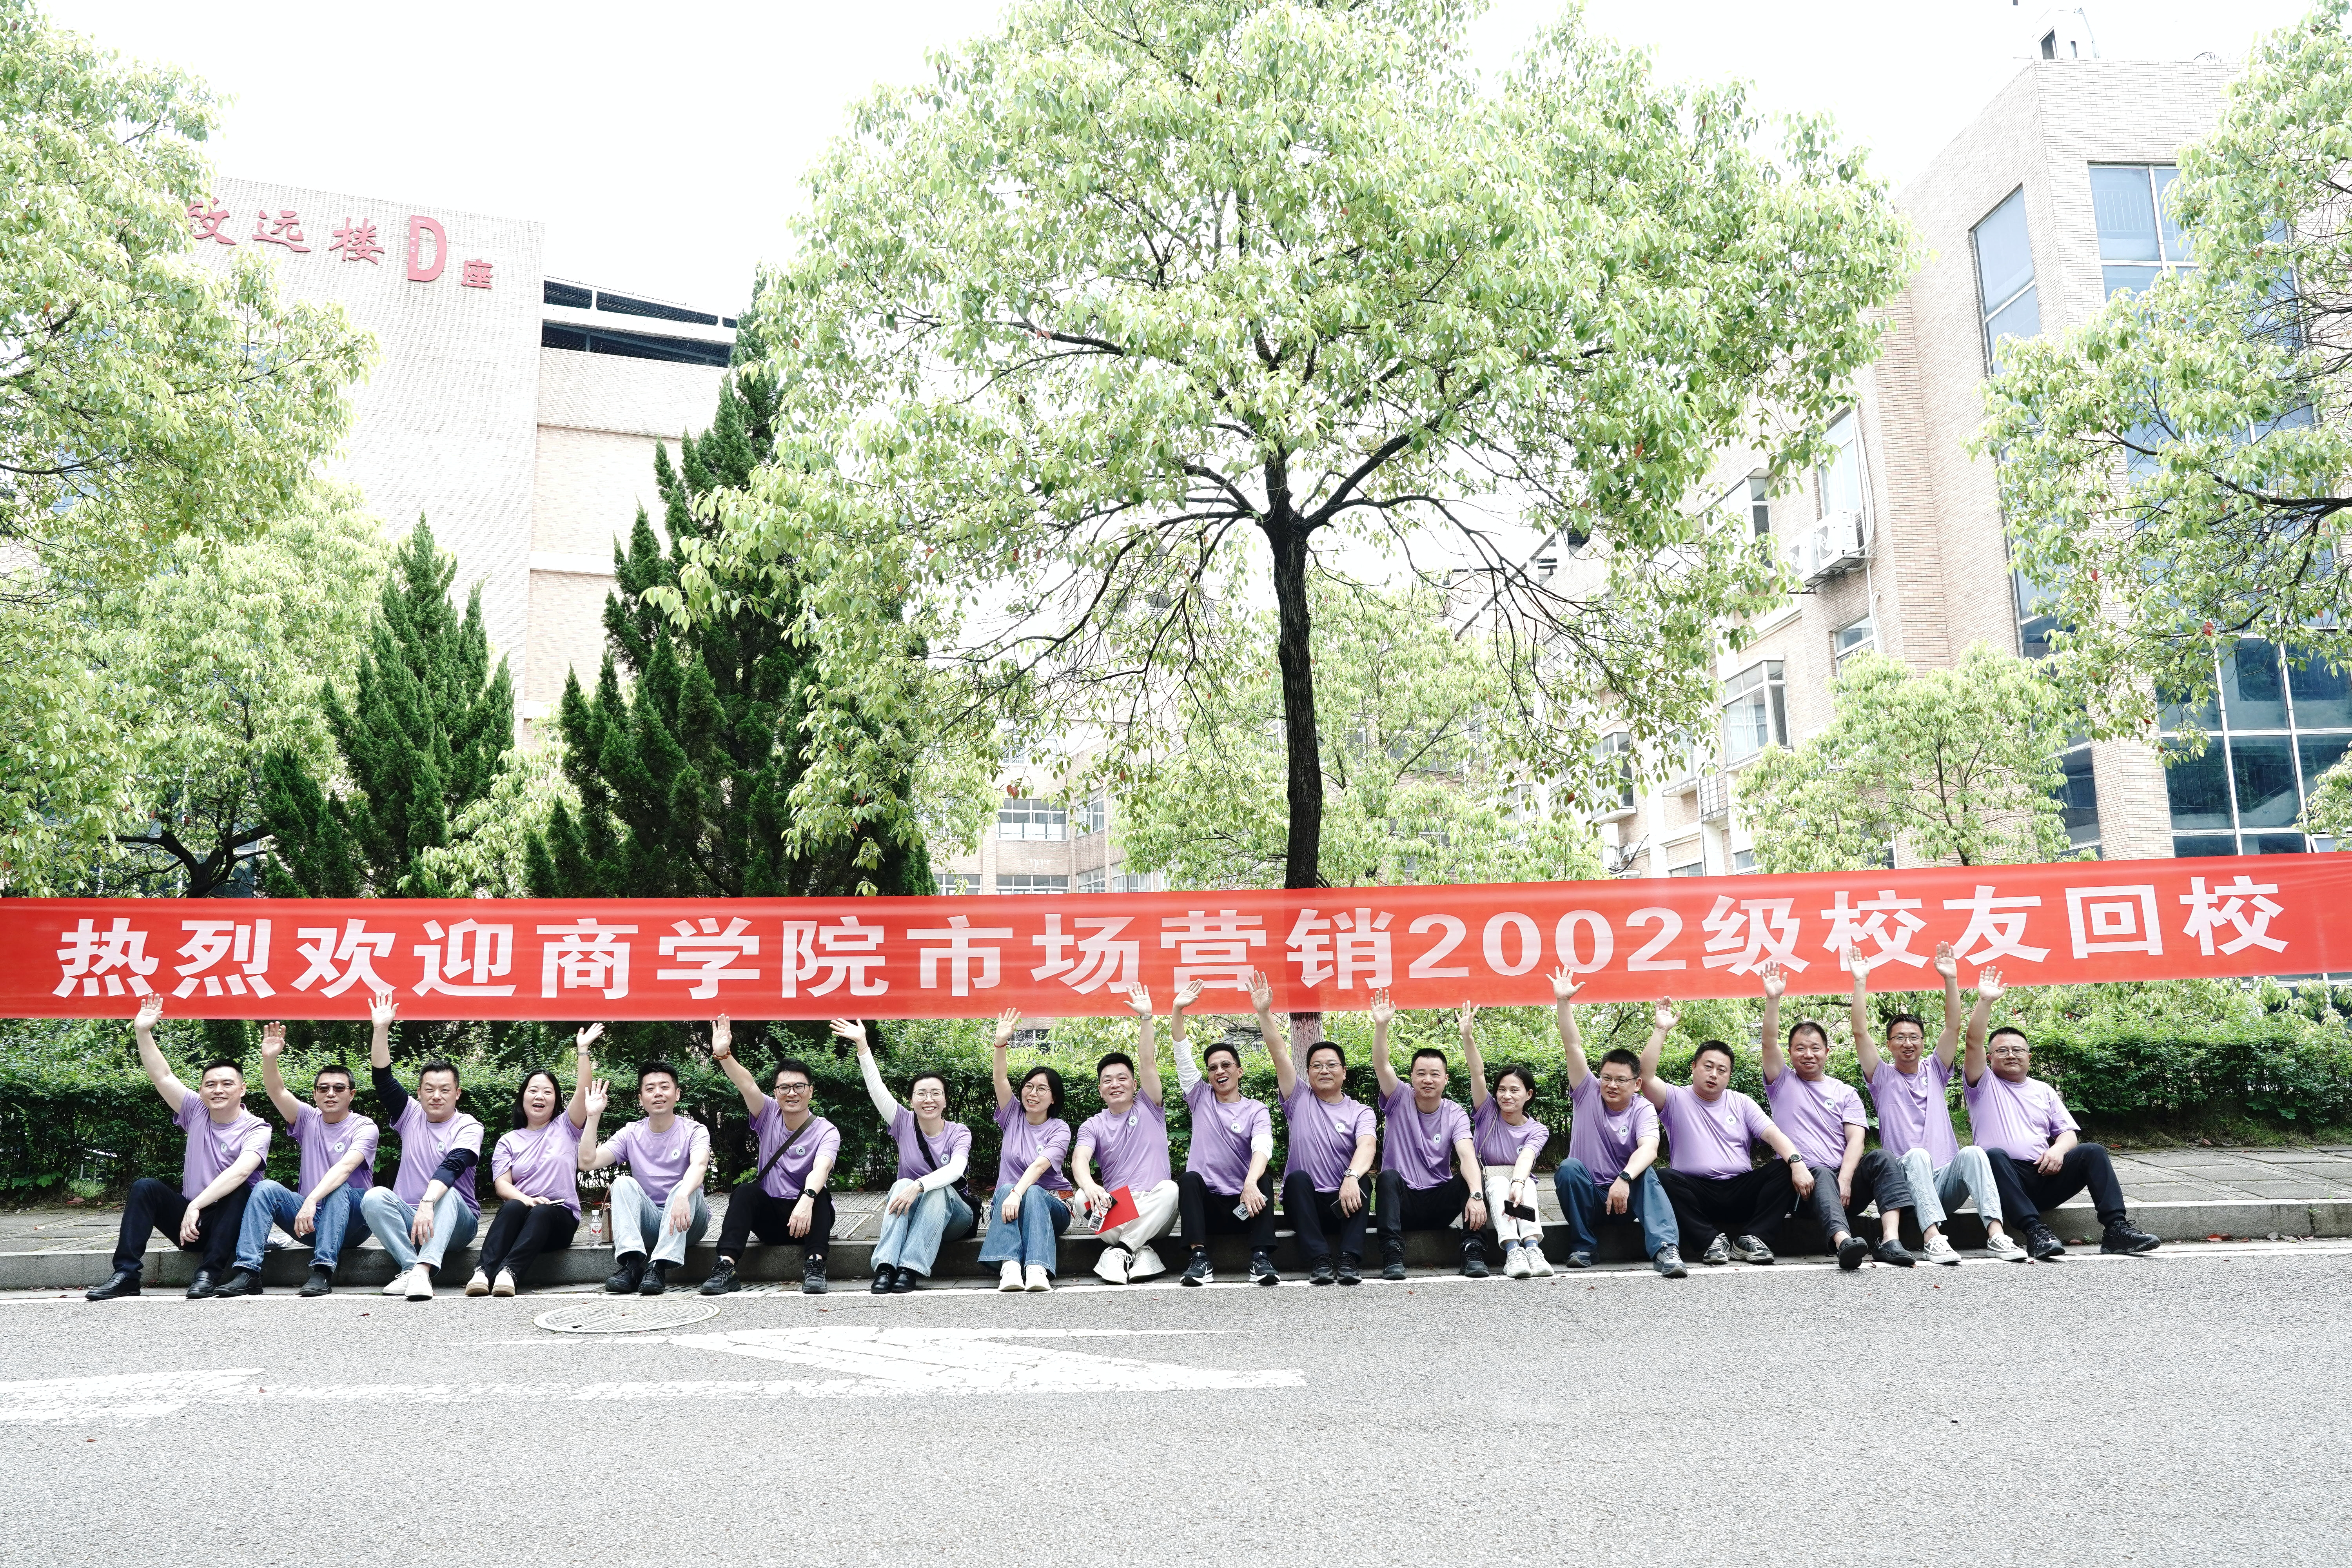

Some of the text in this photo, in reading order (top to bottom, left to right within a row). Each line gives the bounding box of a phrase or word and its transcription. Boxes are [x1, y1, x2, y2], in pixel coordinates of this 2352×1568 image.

[53, 875, 2288, 999] 热烈欢迎商学院市场营销2002级校友回校
